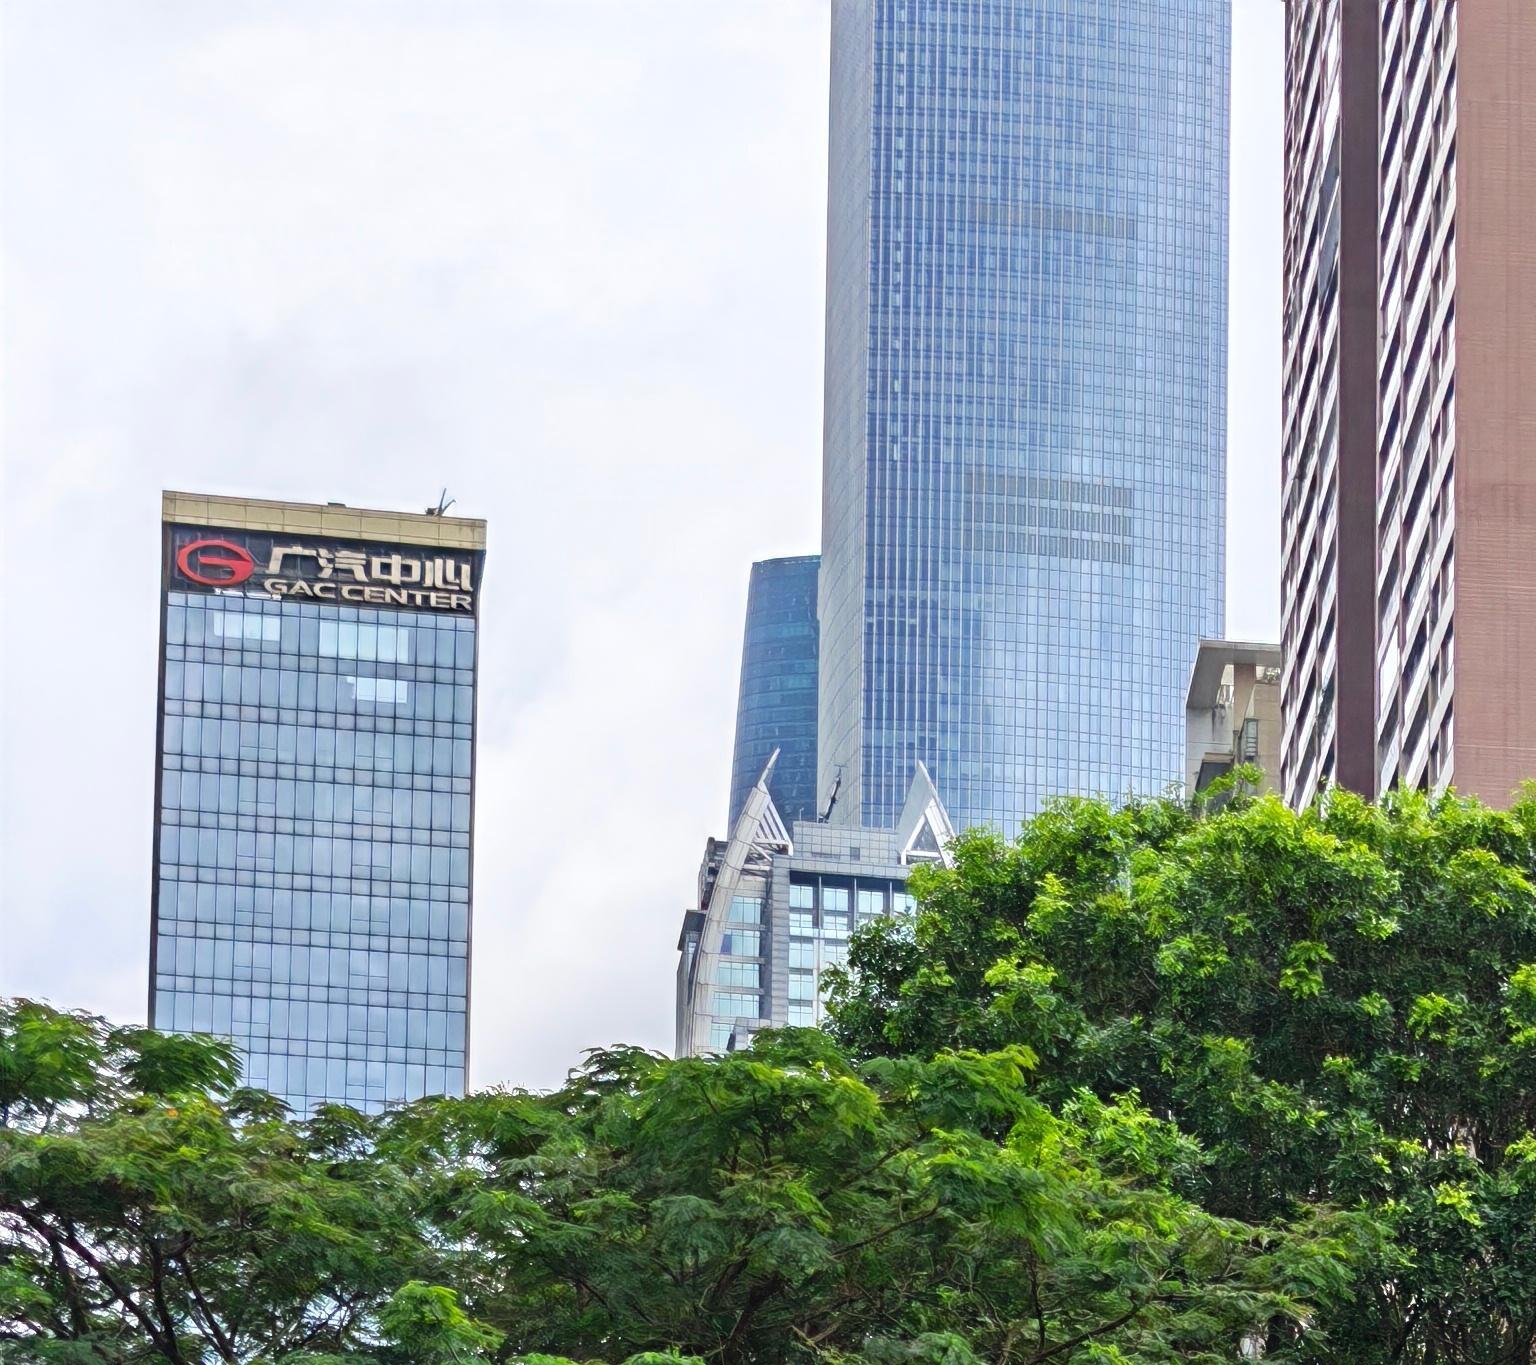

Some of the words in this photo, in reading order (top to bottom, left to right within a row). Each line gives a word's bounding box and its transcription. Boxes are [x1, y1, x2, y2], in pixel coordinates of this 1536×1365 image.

[266, 546, 474, 592] 广汽中心
[264, 579, 337, 600] GAC
[341, 585, 473, 611] CENTER
